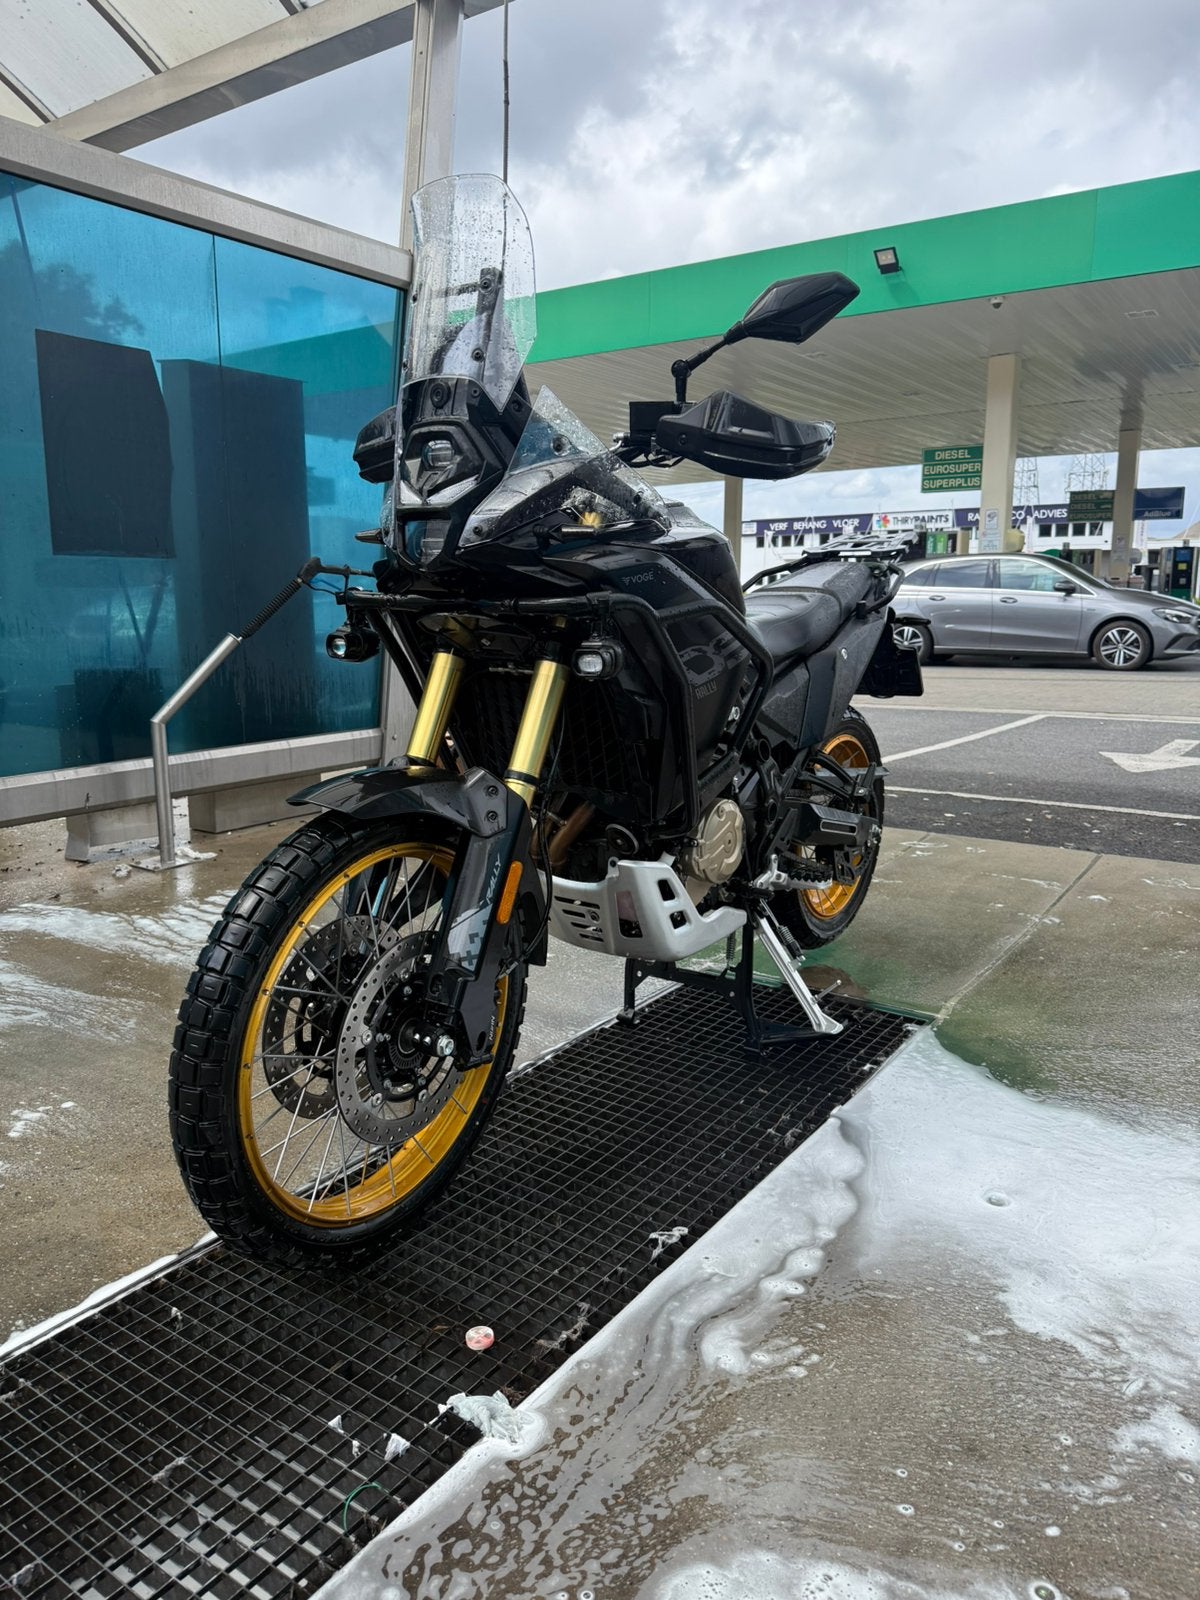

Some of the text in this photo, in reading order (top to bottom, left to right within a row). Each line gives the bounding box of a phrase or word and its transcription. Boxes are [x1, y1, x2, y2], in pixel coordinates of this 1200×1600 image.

[935, 449, 971, 460] DIESEL
[924, 463, 981, 475] EUROSUPER
[923, 477, 980, 489] SUPERPLUS
[1033, 508, 1068, 519] ADVIES
[769, 518, 860, 531] VERF BEHANG VLOER
[630, 571, 654, 583] VOGE
[694, 680, 718, 699] RALLY
[486, 852, 502, 904] RALLY
